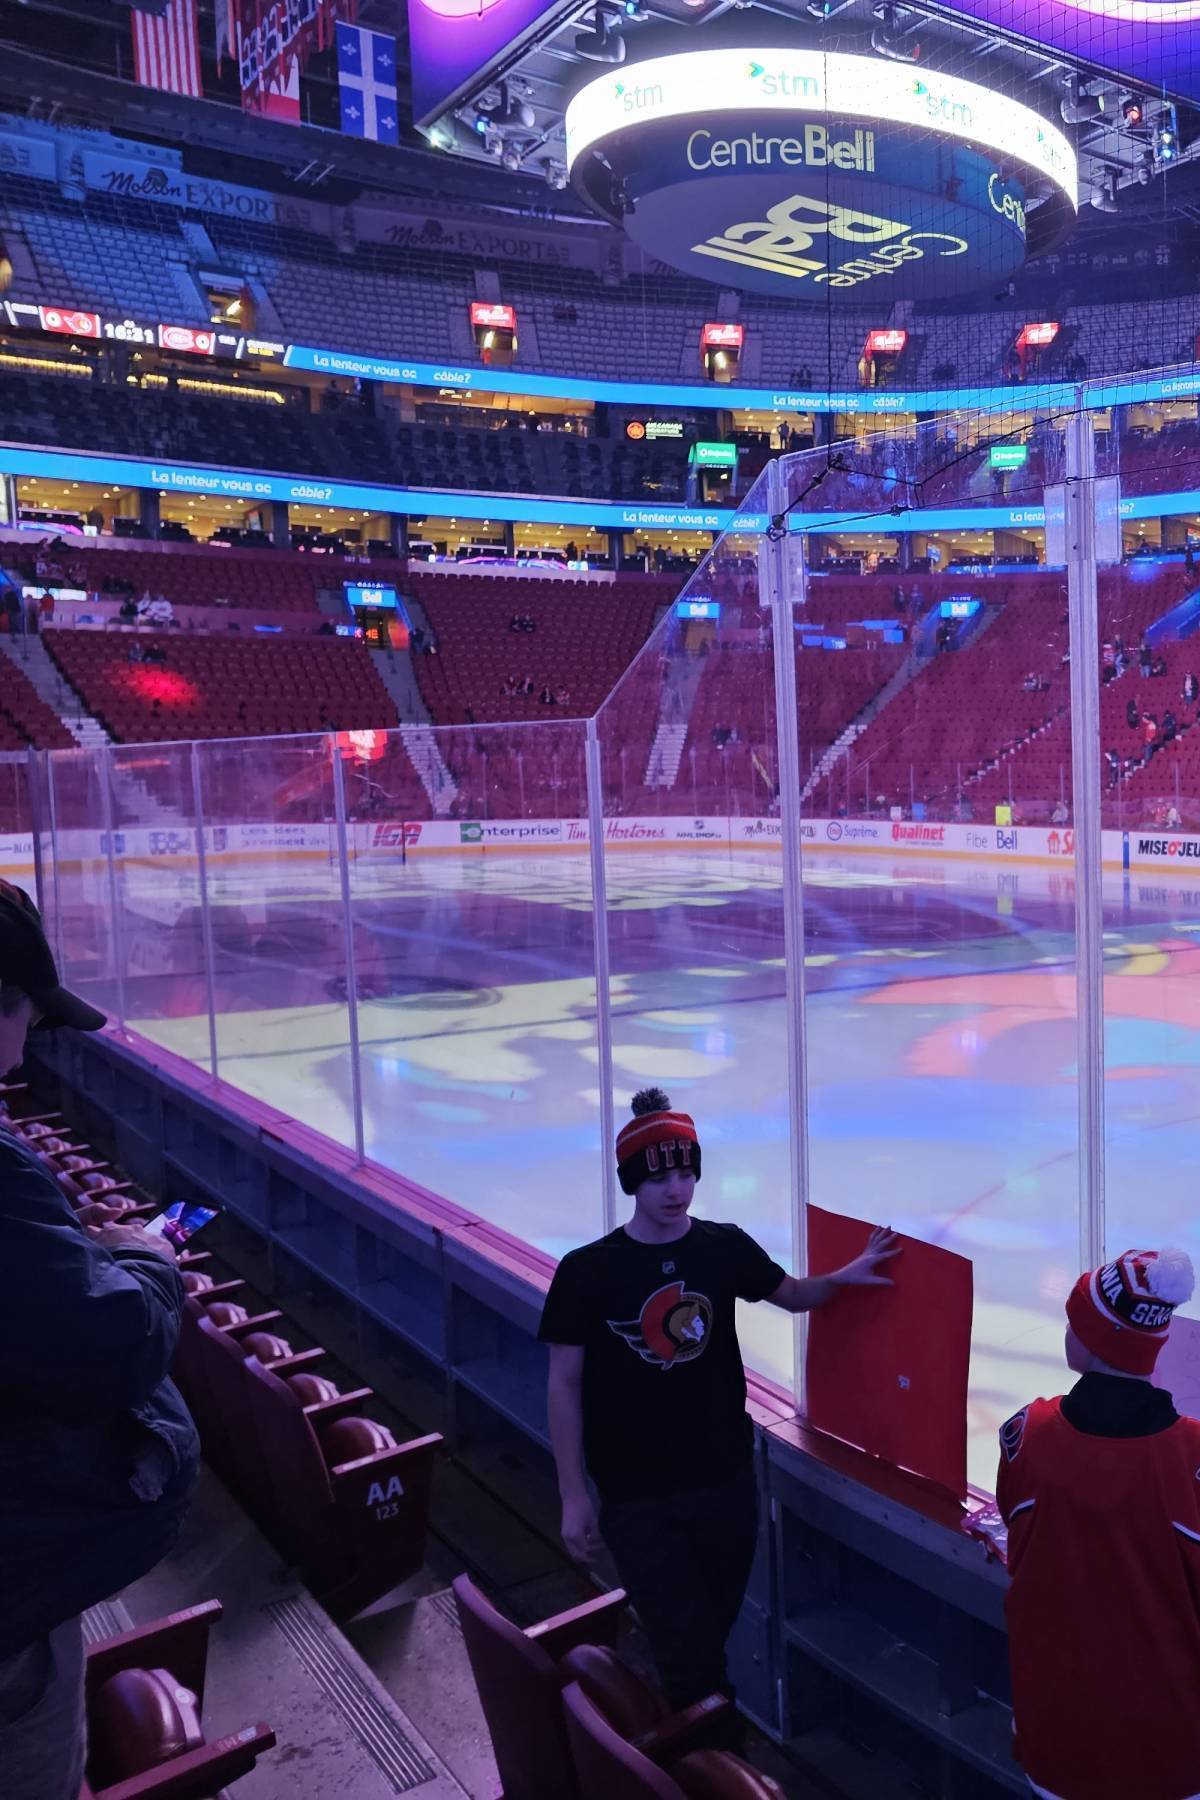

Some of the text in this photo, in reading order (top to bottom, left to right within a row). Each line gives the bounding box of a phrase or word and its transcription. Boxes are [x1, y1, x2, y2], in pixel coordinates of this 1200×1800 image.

[762, 69, 819, 97] stm
[623, 82, 663, 111] stm
[924, 90, 974, 126] stm
[102, 168, 285, 220] Molson EXPORT
[314, 355, 472, 384] La lenteur vous ac câble?
[773, 395, 787, 405] La
[788, 395, 822, 408] lenteur
[151, 470, 333, 501] La lenteur vous ac câble?
[622, 511, 637, 522] La
[638, 511, 677, 524] lenteur
[677, 514, 703, 525] vous
[705, 515, 718, 525] ac
[463, 825, 561, 839] enterprise
[566, 820, 665, 840] Tim Hortons
[892, 823, 945, 841] Qualinet
[966, 830, 1018, 850] Fibe Bell
[367, 1475, 405, 1506] AA
[376, 1502, 400, 1521] 123
